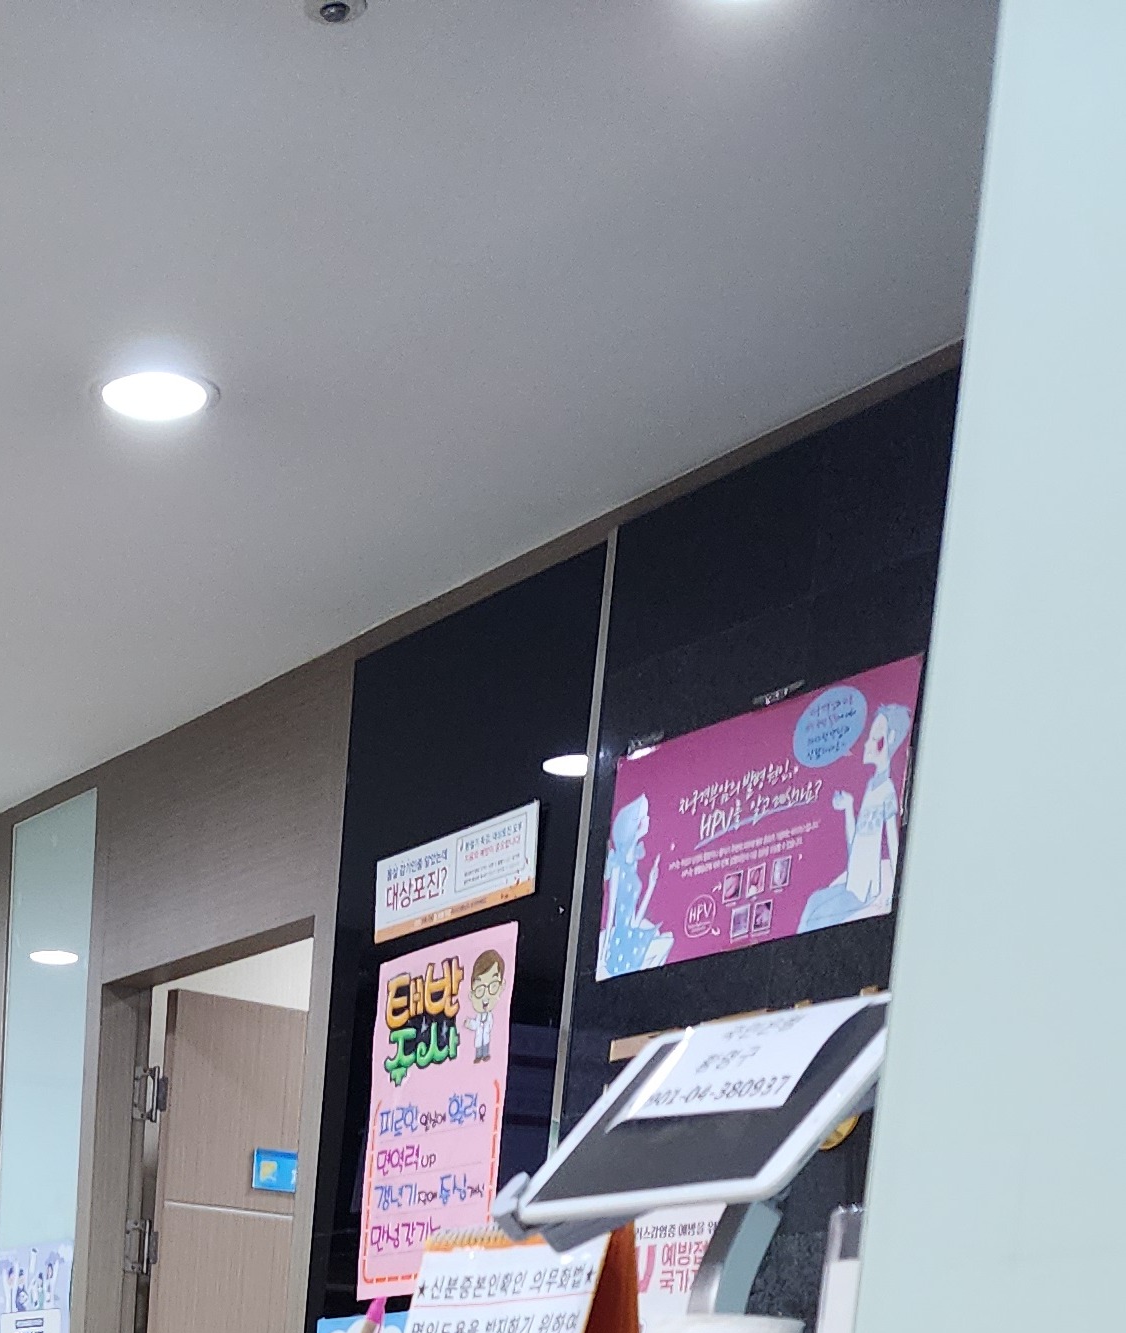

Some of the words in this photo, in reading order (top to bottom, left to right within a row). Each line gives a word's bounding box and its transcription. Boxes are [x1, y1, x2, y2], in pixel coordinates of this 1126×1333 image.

[386, 866, 448, 911] 대상포진?
[688, 902, 713, 925] HPV
[385, 955, 465, 1030] 태반
[384, 1021, 461, 1087] 주사
